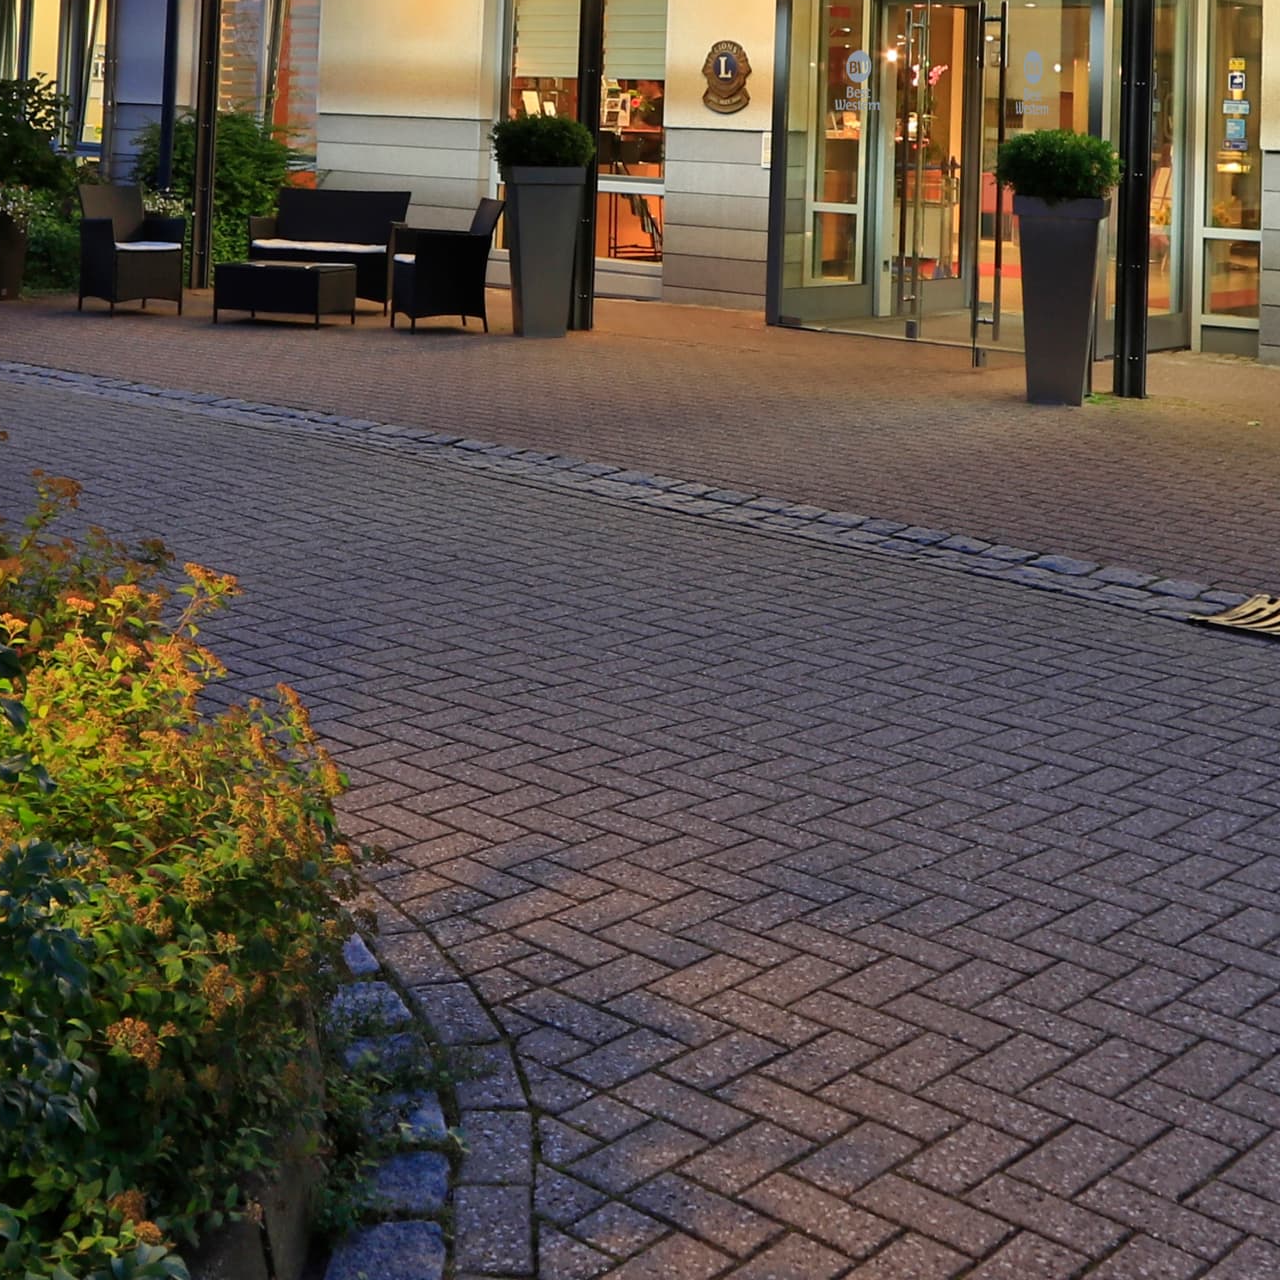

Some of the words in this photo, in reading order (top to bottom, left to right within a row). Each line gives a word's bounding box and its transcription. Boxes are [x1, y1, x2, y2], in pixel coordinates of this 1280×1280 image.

[713, 42, 738, 54] LIONS
[718, 56, 732, 78] L
[850, 61, 869, 74] BW
[846, 86, 871, 99] Best
[835, 99, 881, 111] Western
